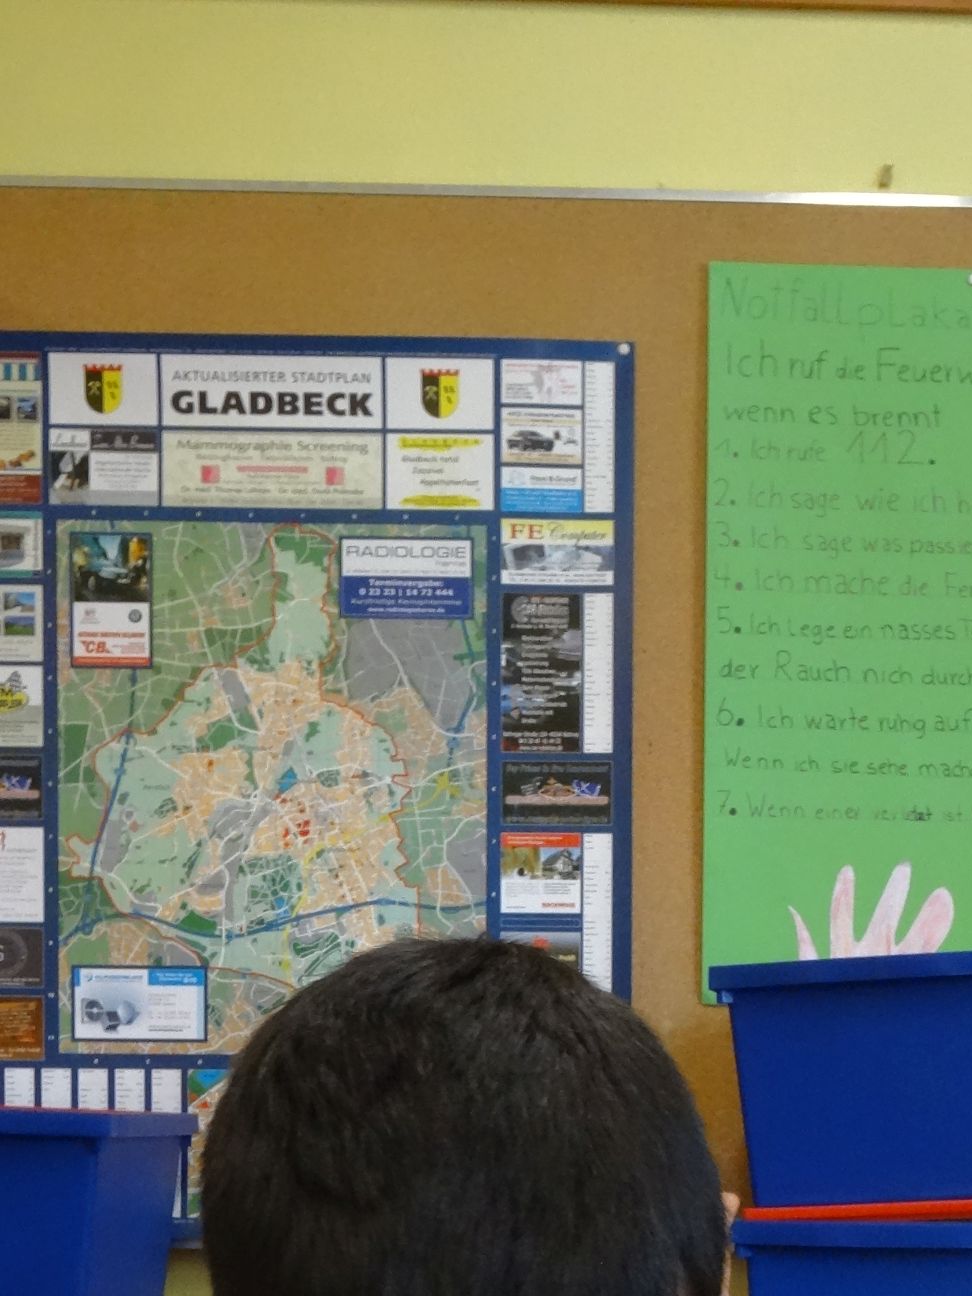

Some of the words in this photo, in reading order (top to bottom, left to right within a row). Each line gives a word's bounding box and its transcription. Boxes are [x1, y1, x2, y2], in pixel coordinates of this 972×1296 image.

[726, 340, 779, 380] Ich
[789, 349, 829, 381] ruf
[171, 369, 286, 384] AKTUALISIERTER
[291, 371, 372, 385] STADTPLAN
[171, 389, 374, 418] GLADBECK
[724, 404, 795, 426] wenn
[807, 403, 839, 426] es
[852, 402, 942, 429] brennt
[297, 440, 369, 455] Screening
[750, 436, 781, 462] Ich
[747, 481, 783, 511] Ich
[790, 491, 841, 518] sage
[855, 487, 901, 513] wie
[912, 485, 947, 514] ich
[509, 523, 544, 541] FE
[750, 525, 788, 550] Ich
[802, 532, 853, 560] sage
[862, 539, 904, 554] was
[346, 545, 467, 559] RADIOLOGIE
[754, 567, 795, 593] Ich
[803, 567, 891, 597] mache
[898, 574, 929, 598] die
[717, 605, 742, 634] 5.
[749, 613, 780, 636] Ich
[842, 620, 872, 640] ein
[880, 621, 957, 641] nasses
[720, 659, 760, 681] der
[774, 649, 852, 683] Rauch
[716, 697, 746, 728] 6.
[758, 704, 795, 730] Ich
[804, 707, 871, 732] warte
[724, 747, 785, 770] Wenn
[794, 756, 820, 774] ich
[831, 759, 860, 776] sie
[746, 792, 806, 820] Wenn
